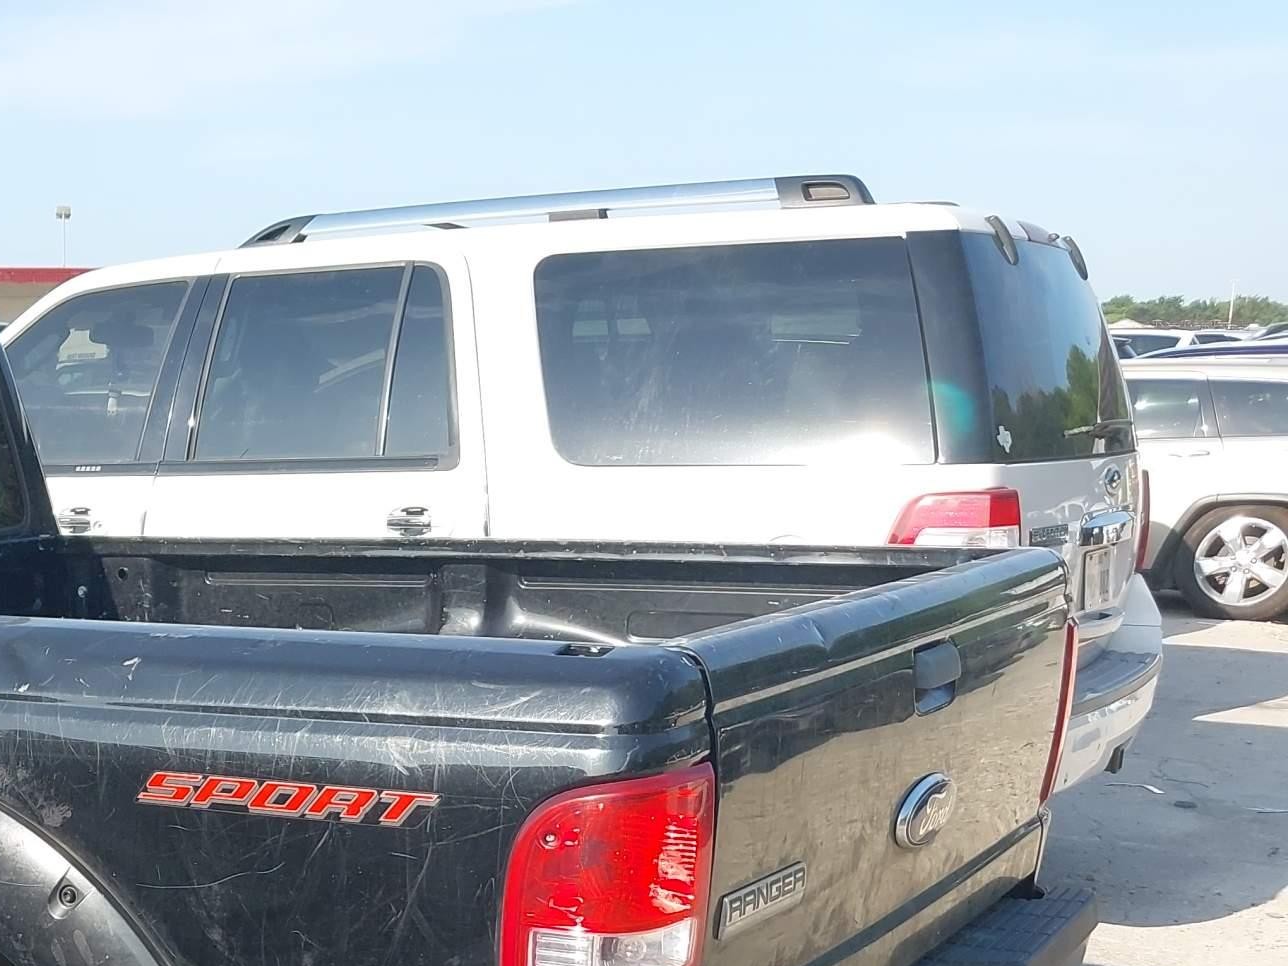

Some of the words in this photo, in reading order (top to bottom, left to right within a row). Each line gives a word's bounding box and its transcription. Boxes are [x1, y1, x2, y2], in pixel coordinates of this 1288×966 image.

[137, 771, 441, 826] SPORT
[918, 790, 954, 837] Ford
[728, 866, 806, 923] RANGER
